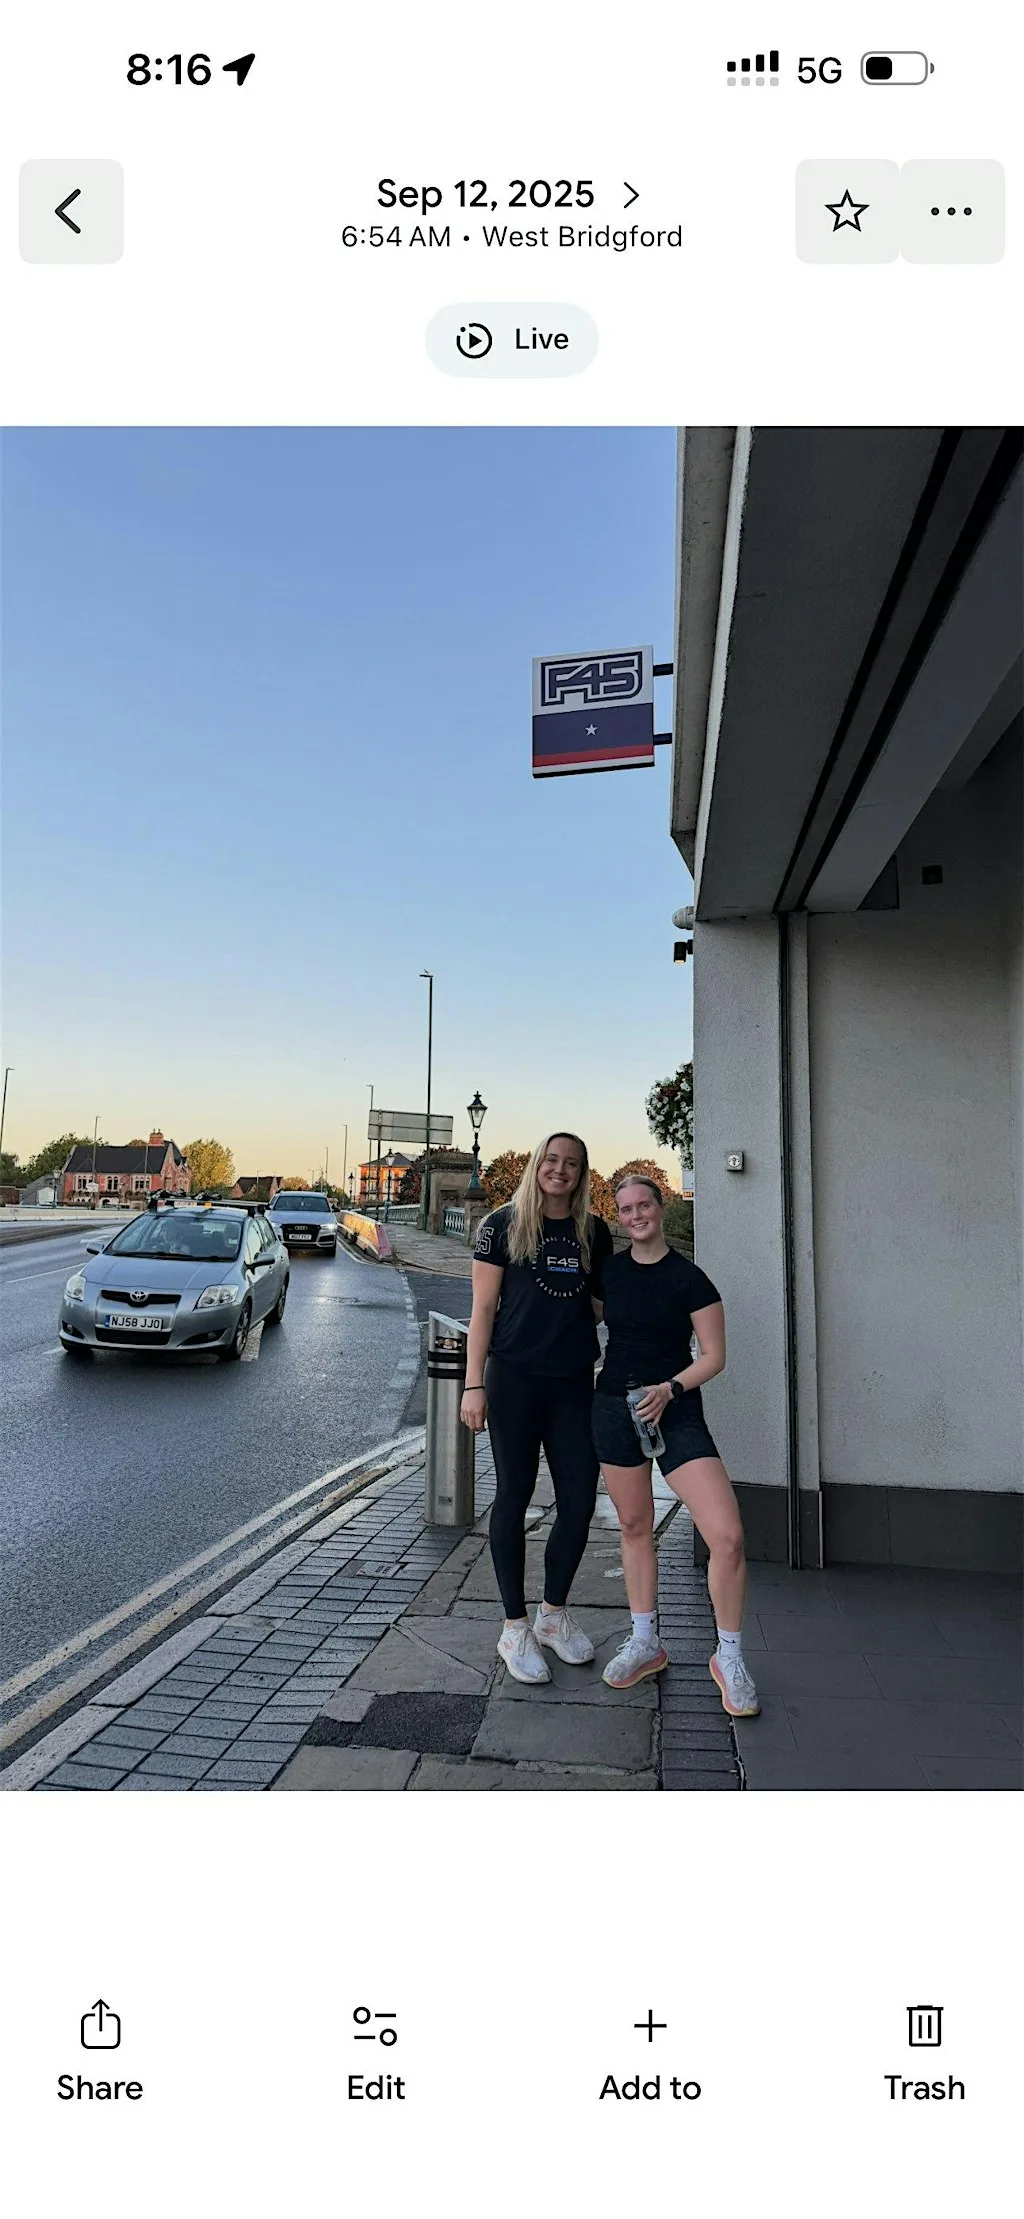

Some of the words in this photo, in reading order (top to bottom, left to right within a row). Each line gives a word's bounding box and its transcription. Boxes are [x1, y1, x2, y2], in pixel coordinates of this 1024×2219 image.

[541, 651, 643, 706] F45
[547, 1256, 579, 1268] F45
[111, 1316, 138, 1327] NJ58
